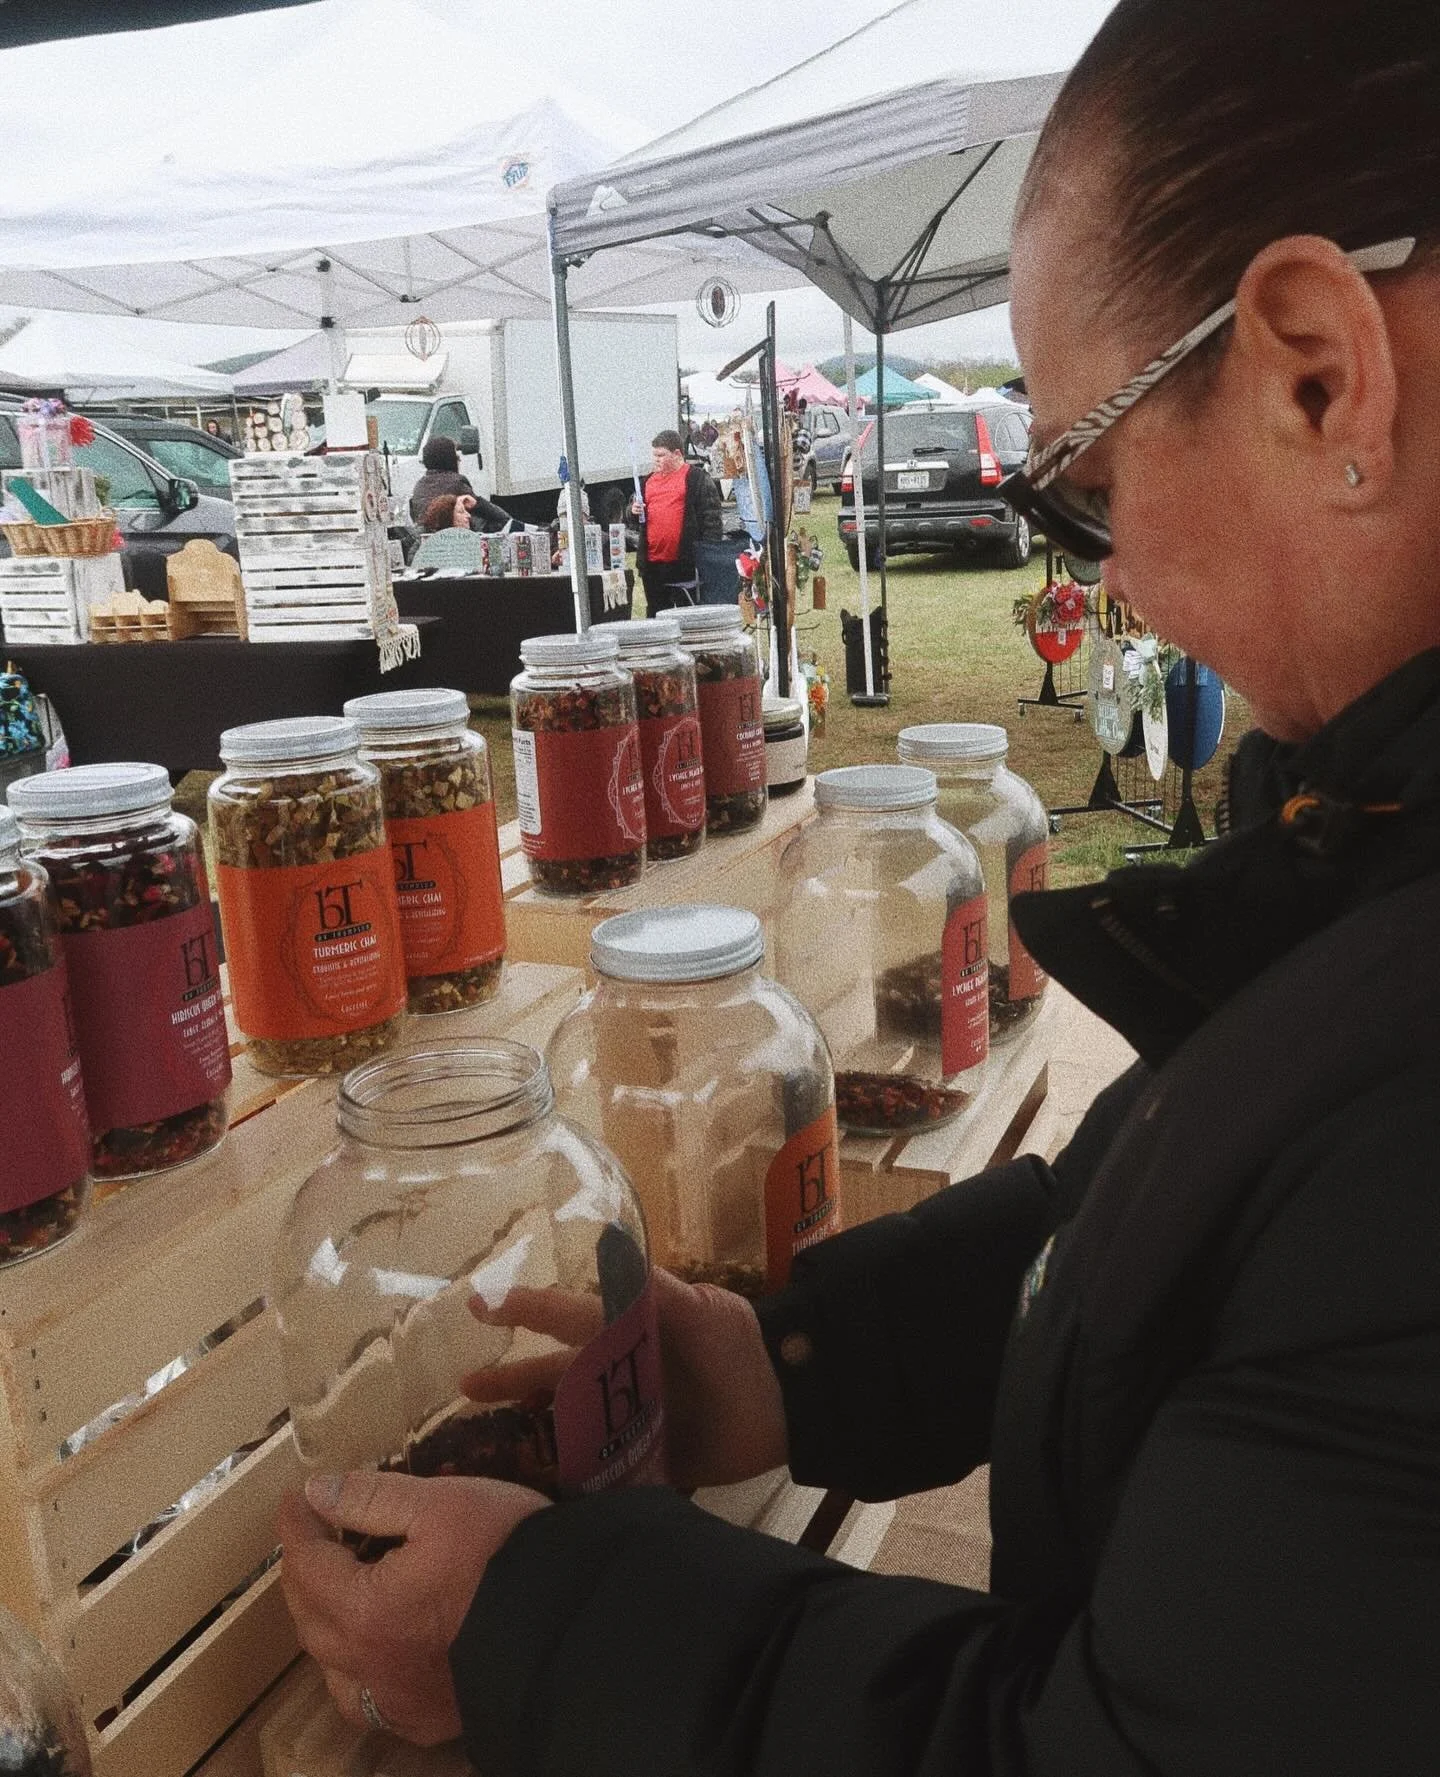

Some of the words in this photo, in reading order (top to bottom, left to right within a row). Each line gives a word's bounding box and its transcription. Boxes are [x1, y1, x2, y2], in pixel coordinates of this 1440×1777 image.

[313, 940, 358, 959] TURMERIC
[360, 934, 378, 949] CHAI
[171, 1003, 201, 1026] HIBISCUS
